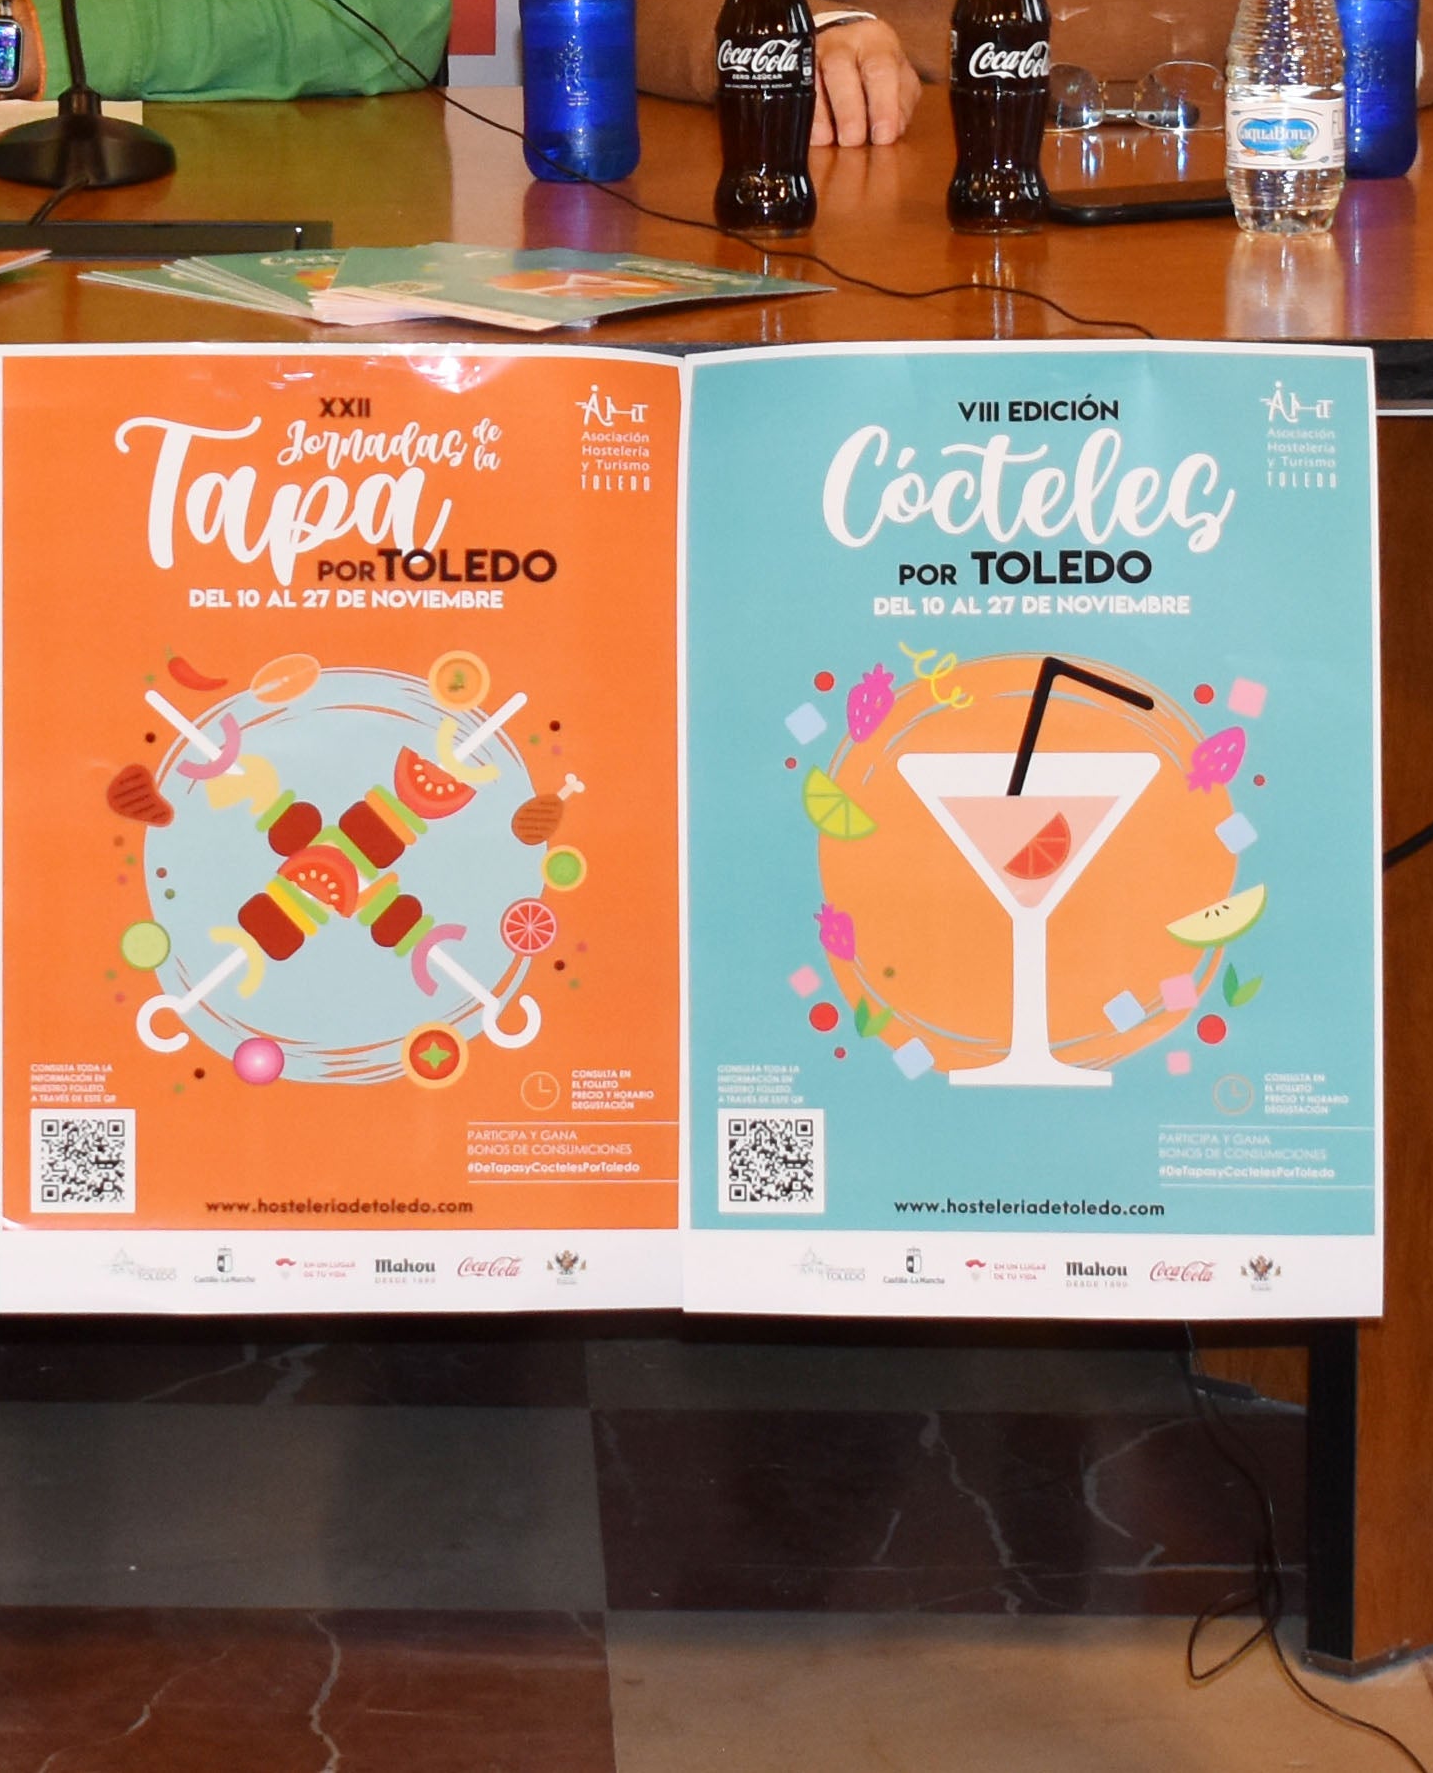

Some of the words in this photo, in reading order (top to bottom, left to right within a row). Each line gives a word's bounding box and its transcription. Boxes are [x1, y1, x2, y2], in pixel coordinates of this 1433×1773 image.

[717, 38, 803, 73] Coca-Cola
[320, 398, 370, 418] XXII
[958, 402, 999, 422] VIII
[1009, 394, 1118, 422] EDICIÓN
[276, 418, 468, 470] Jornadas
[472, 417, 503, 444] de
[580, 429, 651, 443] Asociación
[472, 444, 502, 472] la
[580, 443, 651, 458] Hostelería
[597, 459, 651, 472] Turismo
[580, 474, 652, 492] TOLEDO
[822, 424, 1236, 554] Cócteles
[114, 414, 453, 586] Tapa
[317, 558, 376, 583] POR
[376, 546, 558, 584] TOLEDO
[899, 564, 957, 585] POR
[971, 550, 1152, 584] TOLEDO
[189, 589, 232, 608] DEL
[237, 589, 260, 607] 10
[266, 589, 297, 607] AL
[303, 589, 330, 608] 27
[337, 590, 366, 608] DE
[372, 590, 503, 608] NOVIEMBRE
[874, 597, 916, 616] DEL
[922, 597, 945, 615] 10
[951, 597, 981, 615] AL
[988, 596, 1015, 614] 27
[1022, 595, 1051, 614] DE
[1057, 595, 1190, 614] NOVIEMBRE
[466, 1129, 528, 1141] PARTICIPA
[529, 1130, 537, 1141] Y
[539, 1129, 578, 1141] GANA
[466, 1143, 511, 1156] BONOS
[512, 1143, 528, 1156] DE
[530, 1143, 633, 1157] CONSUMICIONES
[206, 1198, 473, 1213] www.hosteleriadetoledo.com
[894, 1198, 1164, 1215] www.hosteleriadetoledo.com
[1065, 1260, 1128, 1277] Mahou
